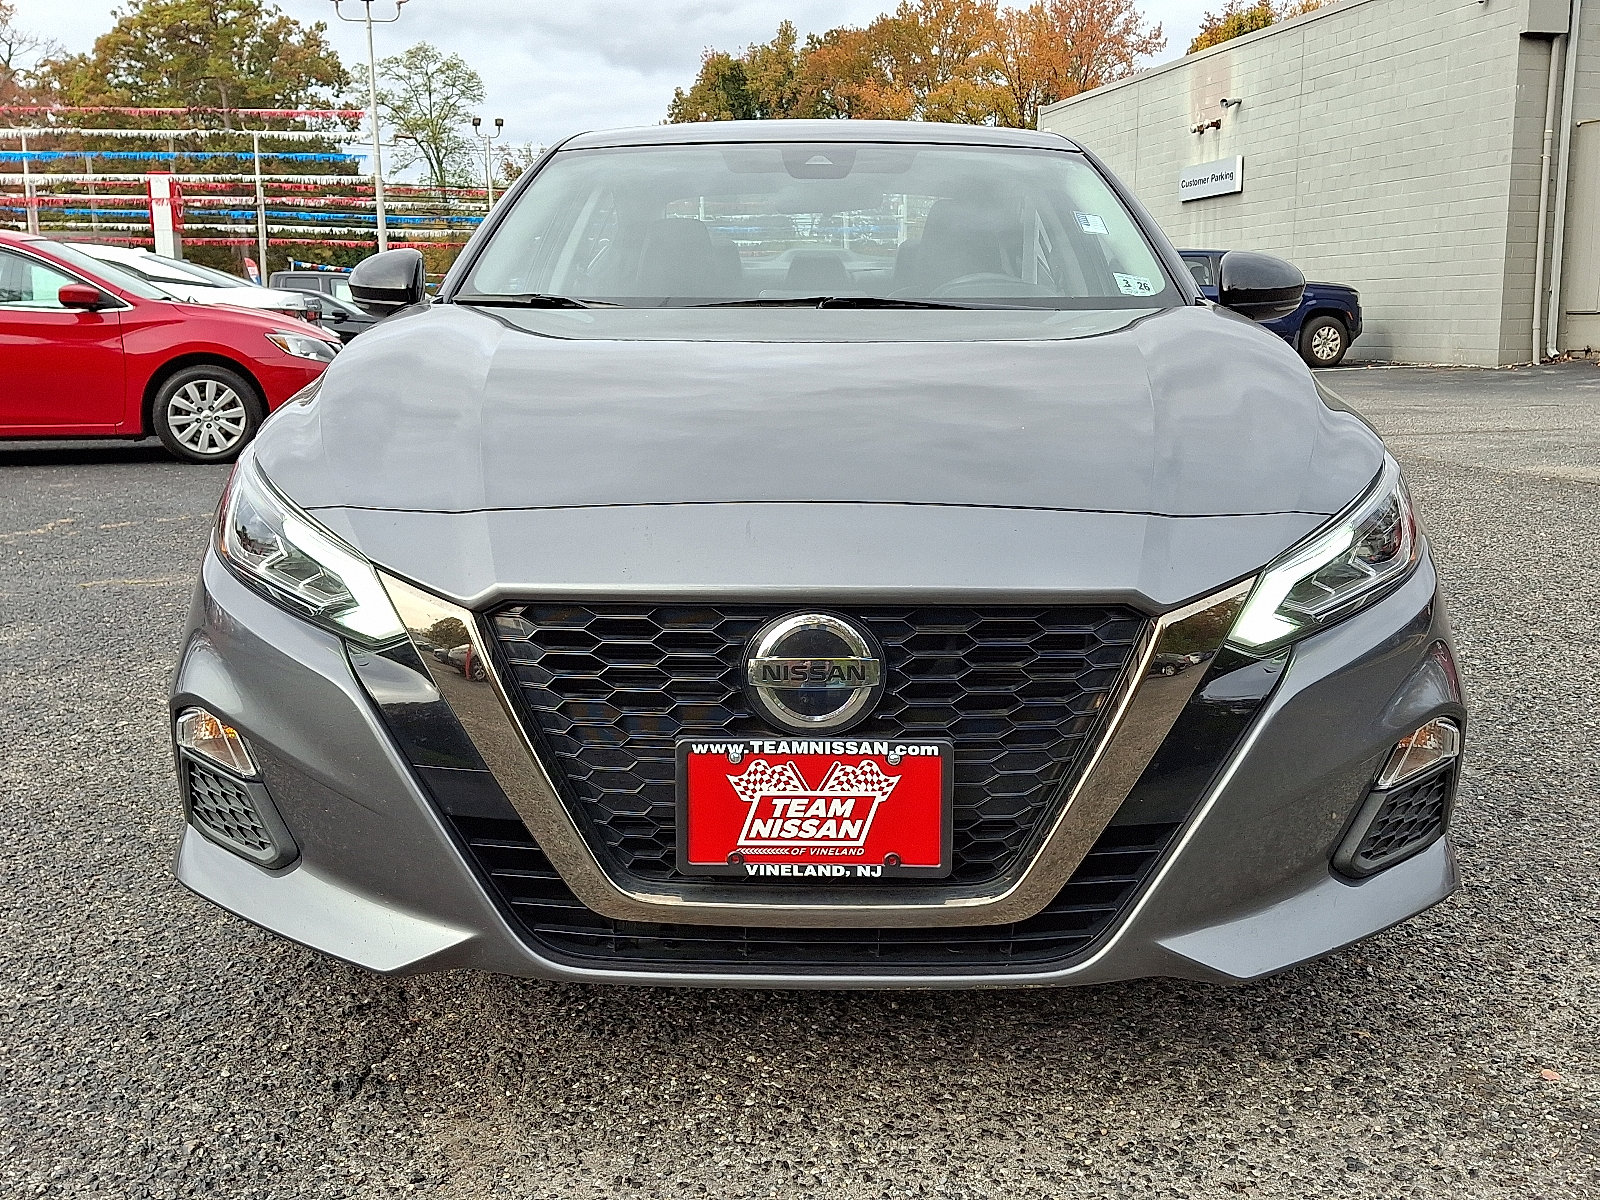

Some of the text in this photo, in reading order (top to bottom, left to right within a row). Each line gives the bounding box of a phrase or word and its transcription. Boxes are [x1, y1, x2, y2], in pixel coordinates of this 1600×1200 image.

[1181, 171, 1234, 189] Customer Parking
[1136, 281, 1151, 292] 26
[762, 664, 866, 682] NISSAN
[691, 740, 940, 756] www.TEAMNISSAN.com
[771, 798, 856, 818] TEAM
[749, 818, 864, 839] NISSAN
[790, 847, 865, 856] OF VINELAND
[746, 864, 883, 878] VINELAND, NJ
